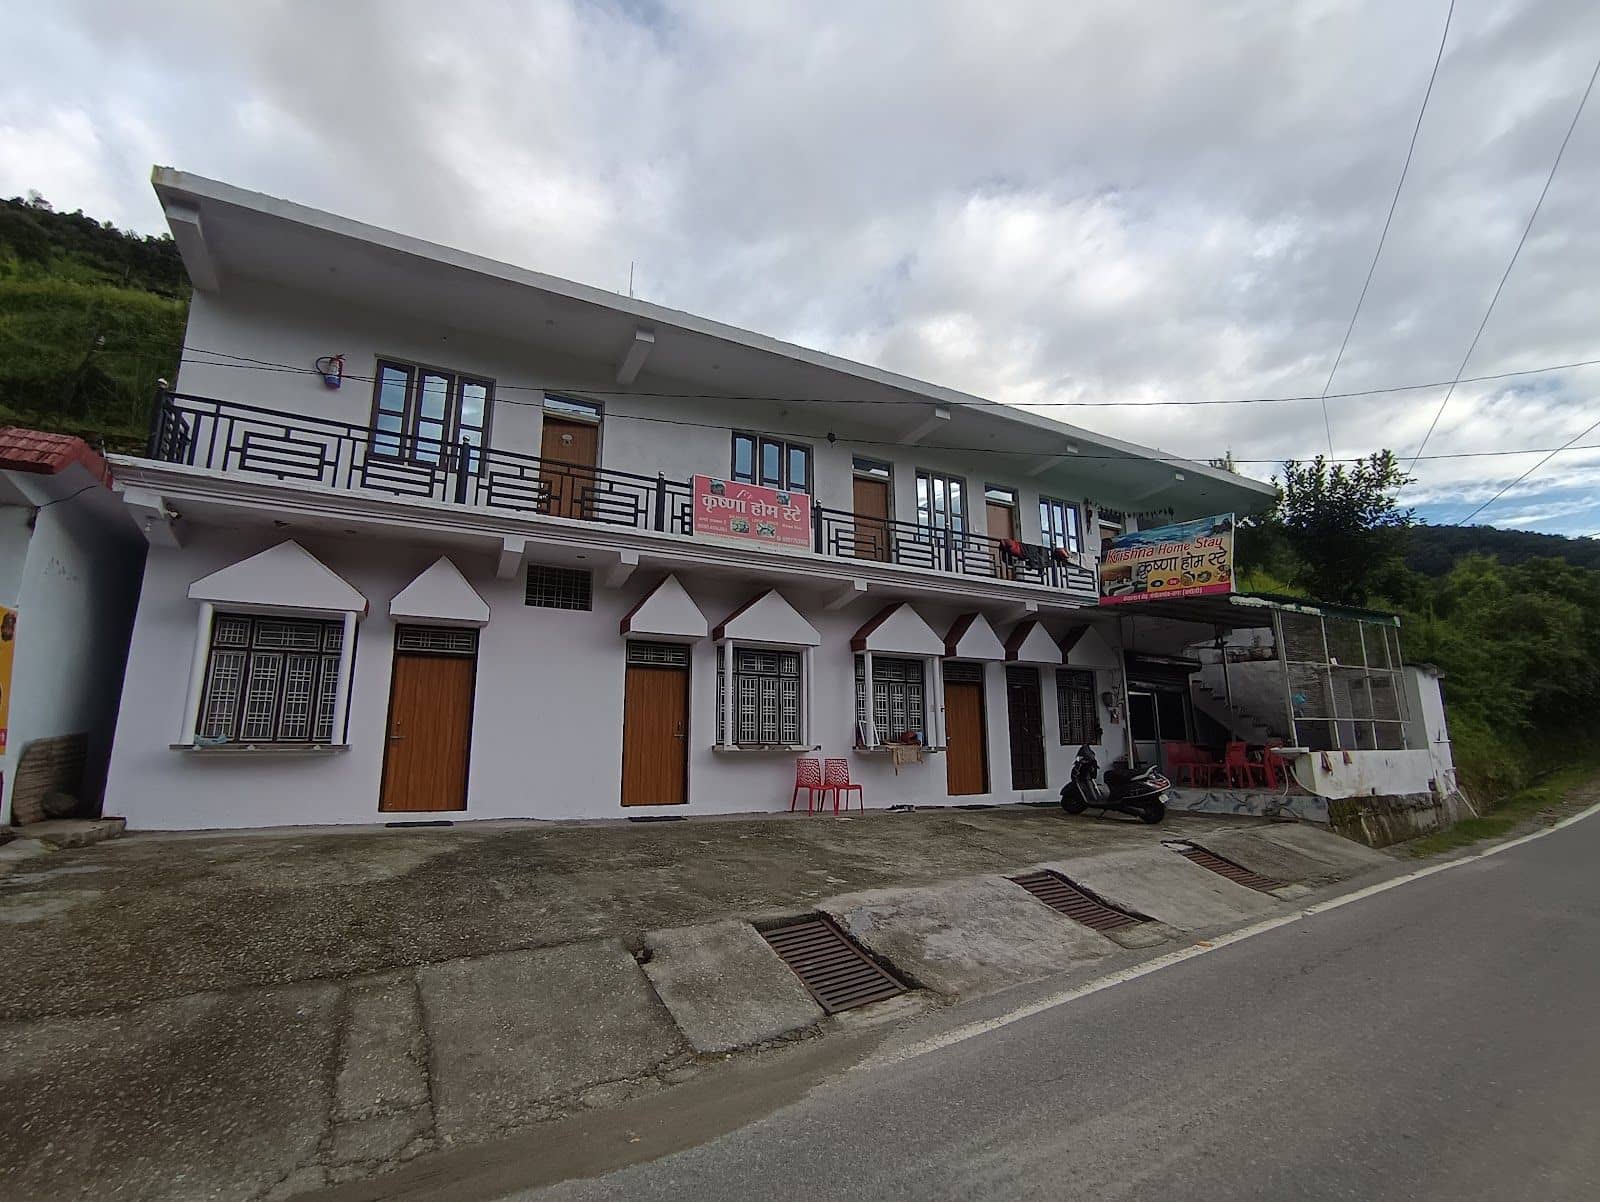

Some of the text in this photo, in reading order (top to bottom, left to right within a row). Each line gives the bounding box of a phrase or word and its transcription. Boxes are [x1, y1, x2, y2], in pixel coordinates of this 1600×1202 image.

[702, 493, 802, 522] कृष्णा होम स्टे
[1106, 537, 1223, 563] Krishna Home Stay
[1137, 546, 1228, 580] कृष्णा होम स्टे
